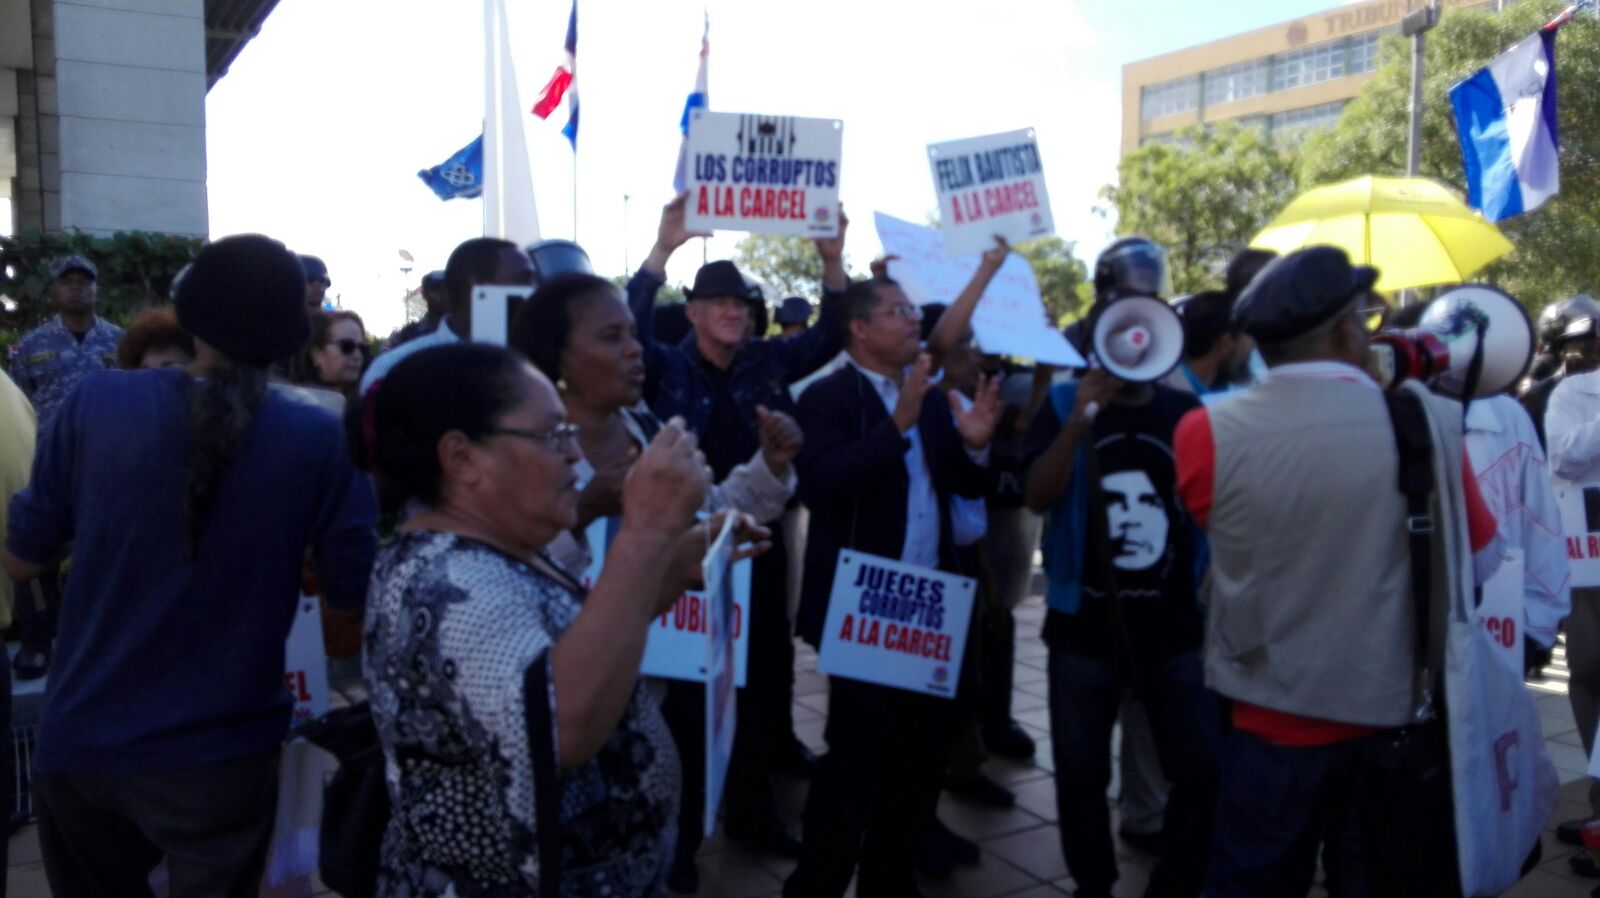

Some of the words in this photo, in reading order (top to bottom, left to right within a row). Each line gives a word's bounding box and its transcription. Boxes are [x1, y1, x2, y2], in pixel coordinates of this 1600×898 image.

[695, 153, 727, 182] LOS
[732, 155, 837, 187] CORRUPTOS
[936, 155, 974, 191] FELIX
[974, 143, 1041, 183] BAUTISTA
[697, 184, 710, 216] A
[714, 185, 735, 217] LA
[740, 186, 806, 219] CARCEL
[951, 194, 965, 224] A
[963, 190, 984, 222] LA
[984, 180, 1039, 217] CARCEL
[854, 563, 946, 605] JUECES
[858, 588, 946, 630] CORRUPTOS
[839, 613, 855, 641] A
[857, 616, 881, 646] LA
[884, 622, 953, 662] CARCEL
